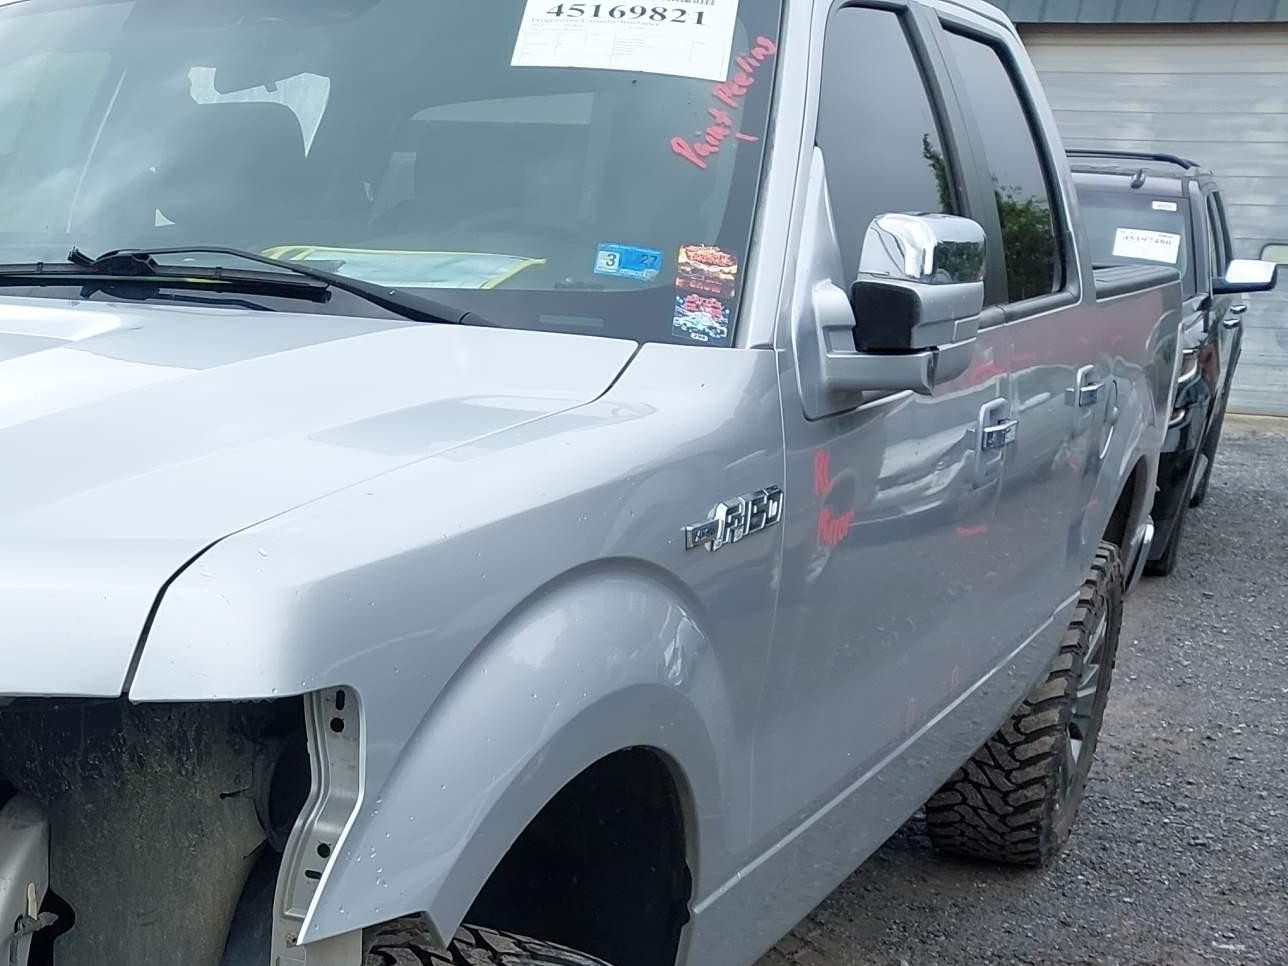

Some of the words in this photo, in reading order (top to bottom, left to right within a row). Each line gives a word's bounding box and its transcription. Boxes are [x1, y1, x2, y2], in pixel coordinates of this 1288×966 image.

[546, 3, 707, 25] 45169821
[605, 253, 617, 267] 3
[640, 253, 658, 267] 27
